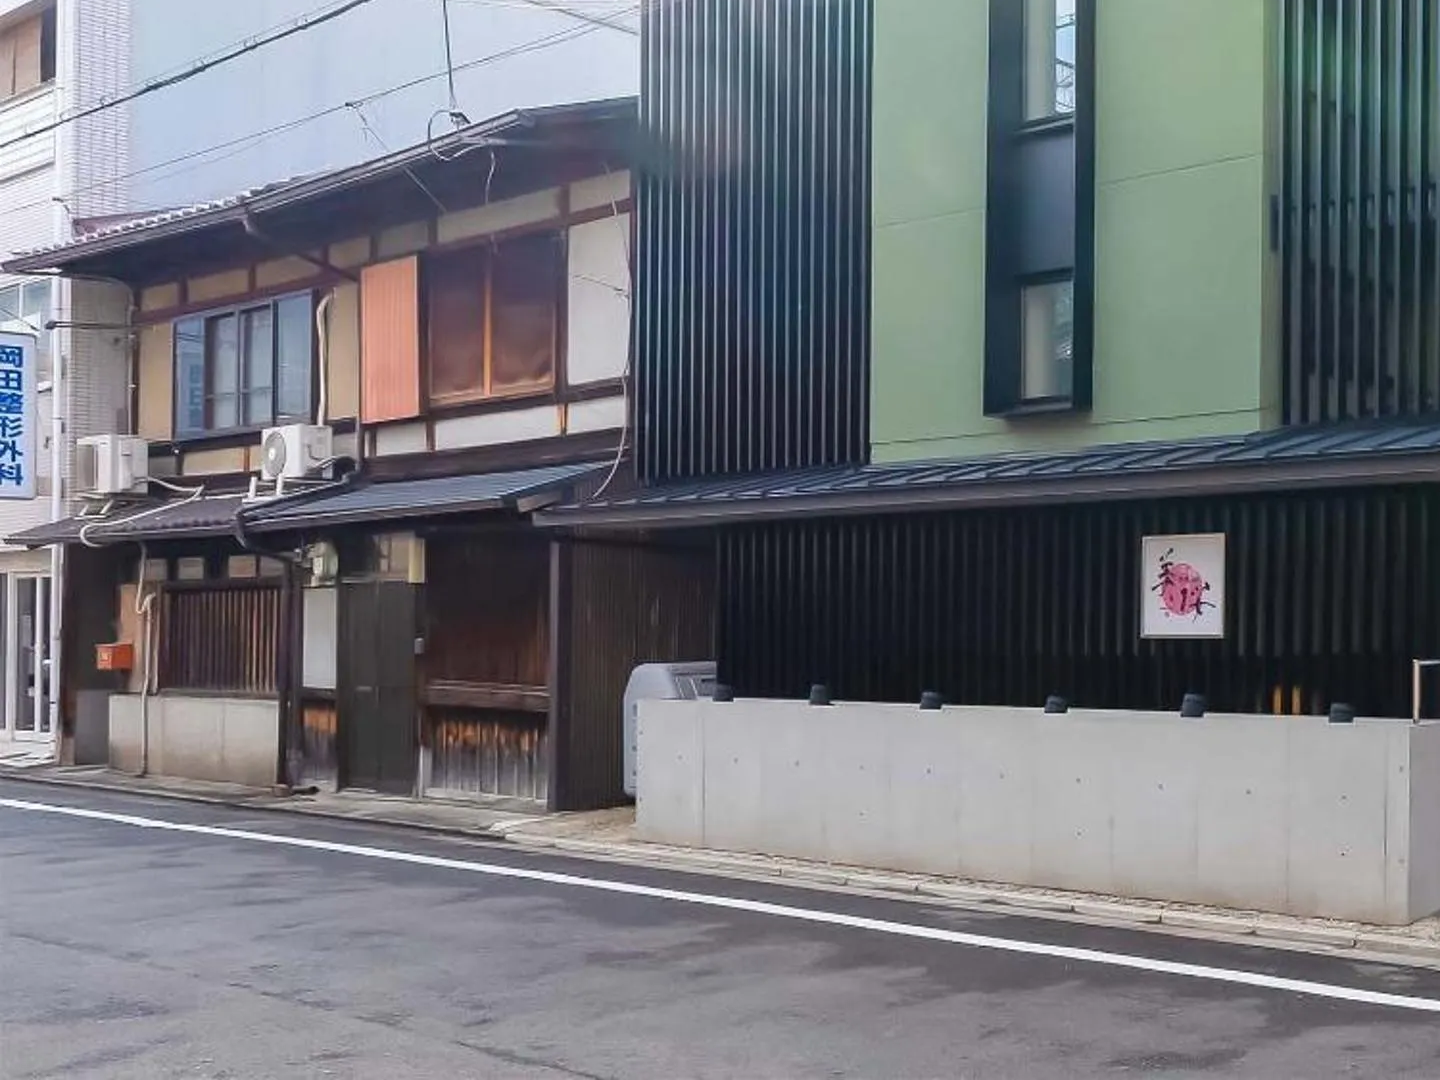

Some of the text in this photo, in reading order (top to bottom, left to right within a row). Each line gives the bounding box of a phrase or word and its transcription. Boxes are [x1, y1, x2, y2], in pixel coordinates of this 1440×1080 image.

[0, 345, 24, 486] 岡田整形外科
